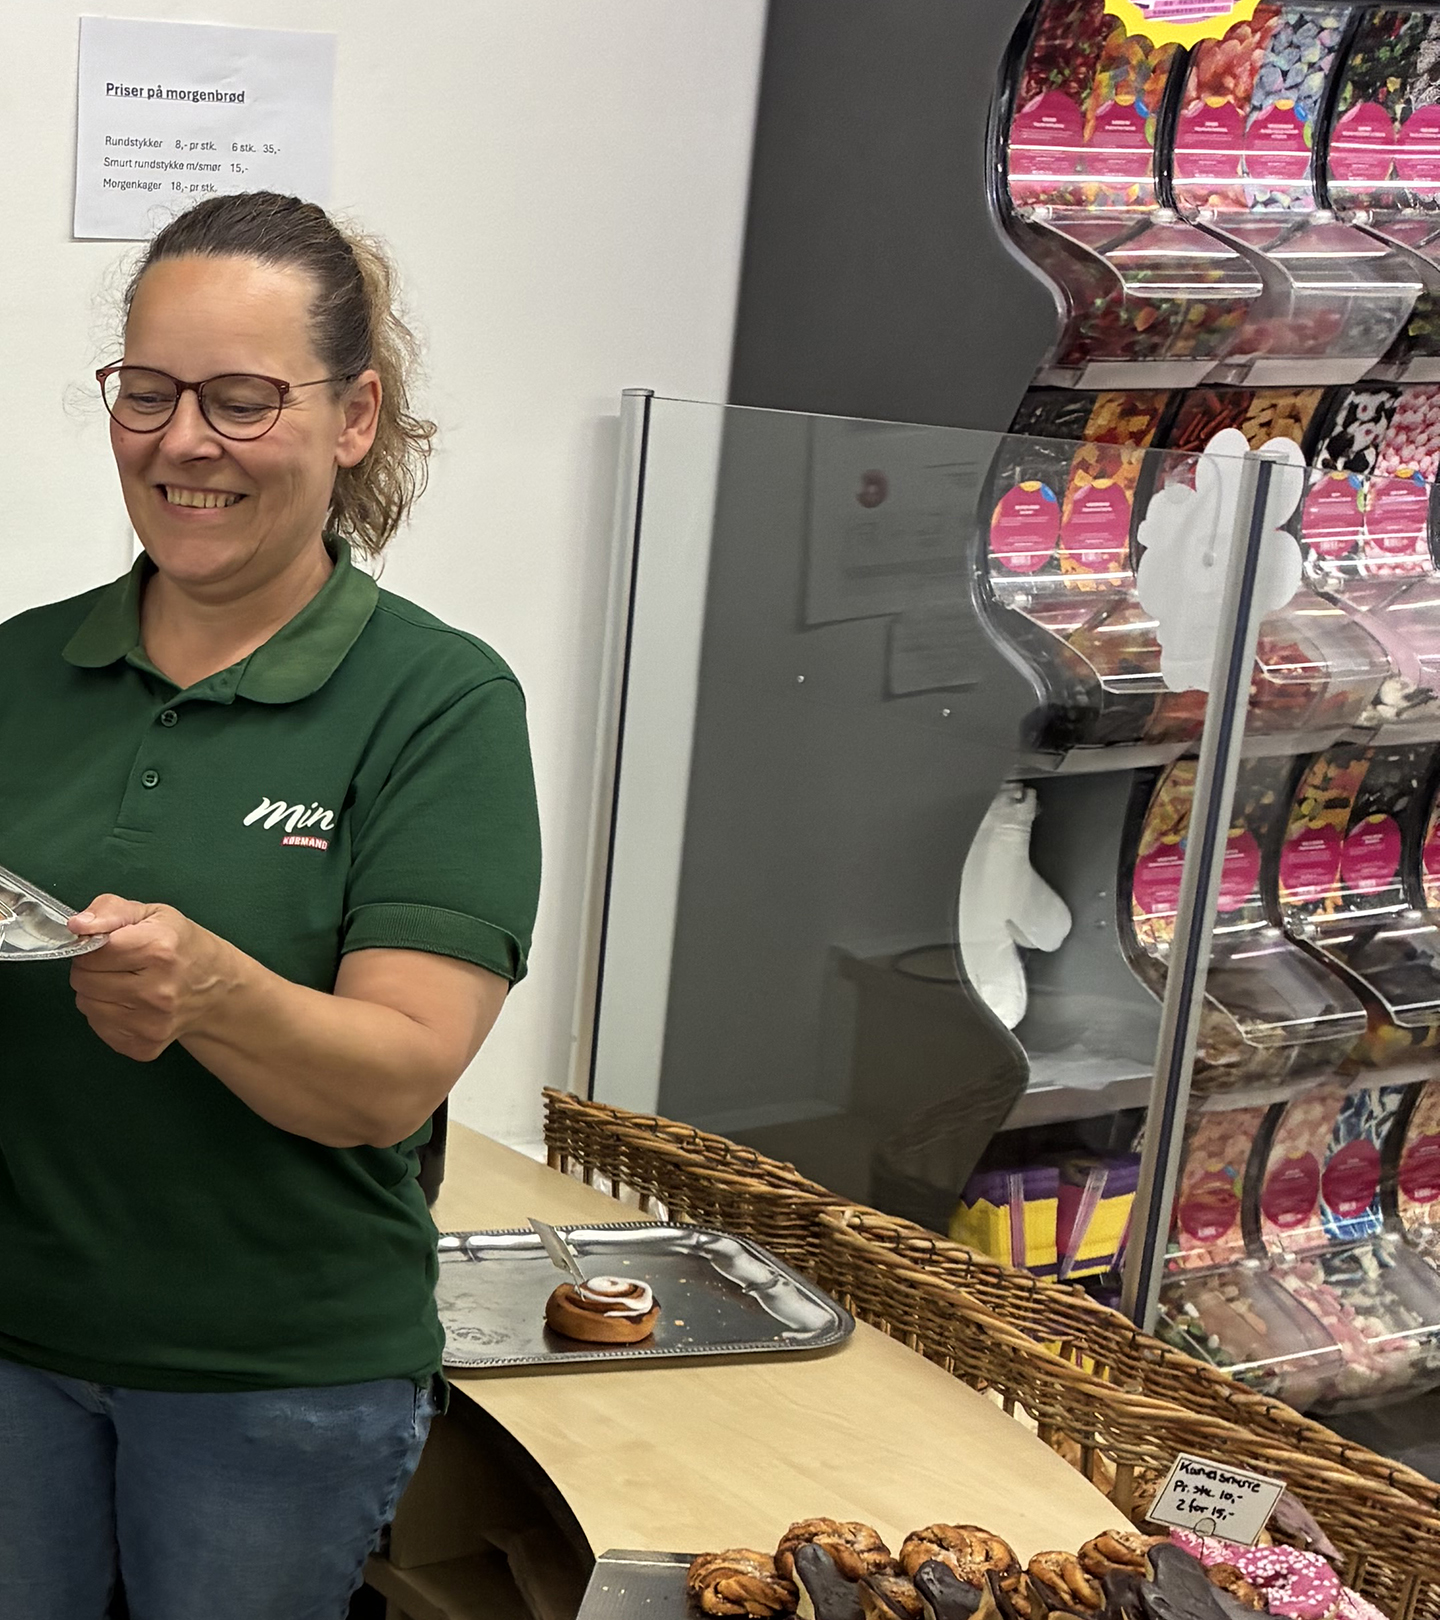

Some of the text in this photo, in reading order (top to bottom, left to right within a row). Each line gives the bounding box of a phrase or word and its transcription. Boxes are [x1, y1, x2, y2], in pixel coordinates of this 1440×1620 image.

[106, 82, 246, 103] Priser på morgenbrød
[105, 136, 163, 149] Rundstykker
[175, 140, 188, 151] 8,-
[189, 142, 199, 151] pr
[200, 140, 217, 151] stk.
[232, 142, 238, 152] 6
[263, 144, 281, 155] 35,-
[104, 157, 249, 174] Smurt rundstykke m/smør 15,-
[103, 178, 162, 191] Morgenkager
[171, 181, 188, 192] 18,-
[189, 183, 199, 193] pr
[243, 796, 335, 833] Min
[1176, 1499, 1185, 1511] 2
[1189, 1498, 1210, 1513] for
